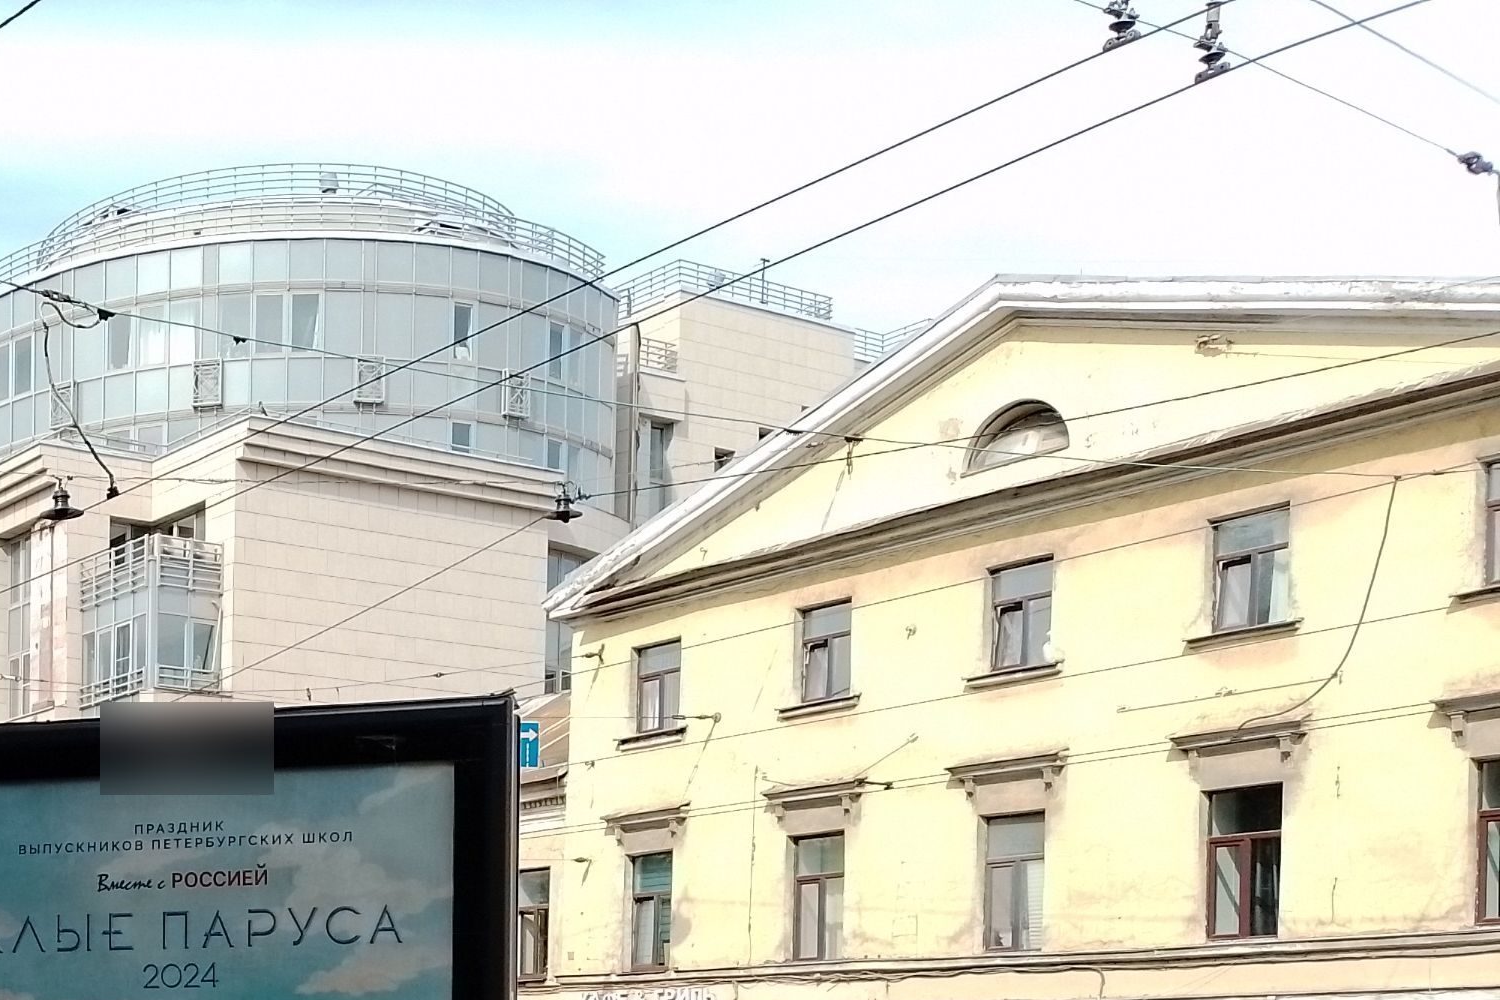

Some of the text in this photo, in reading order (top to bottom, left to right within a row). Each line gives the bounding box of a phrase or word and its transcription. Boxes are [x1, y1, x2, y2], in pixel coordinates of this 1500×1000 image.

[134, 820, 225, 836] ПРАЗДНИК
[18, 831, 354, 855] ВЫПУСКНИКОВ ПЕТЕРБУРГСКИХ ШКОЛ
[97, 872, 153, 894] Вместе
[171, 863, 269, 889] РОССИЕЙ
[162, 903, 403, 950] ПАРУСА
[143, 962, 219, 990] 2024
